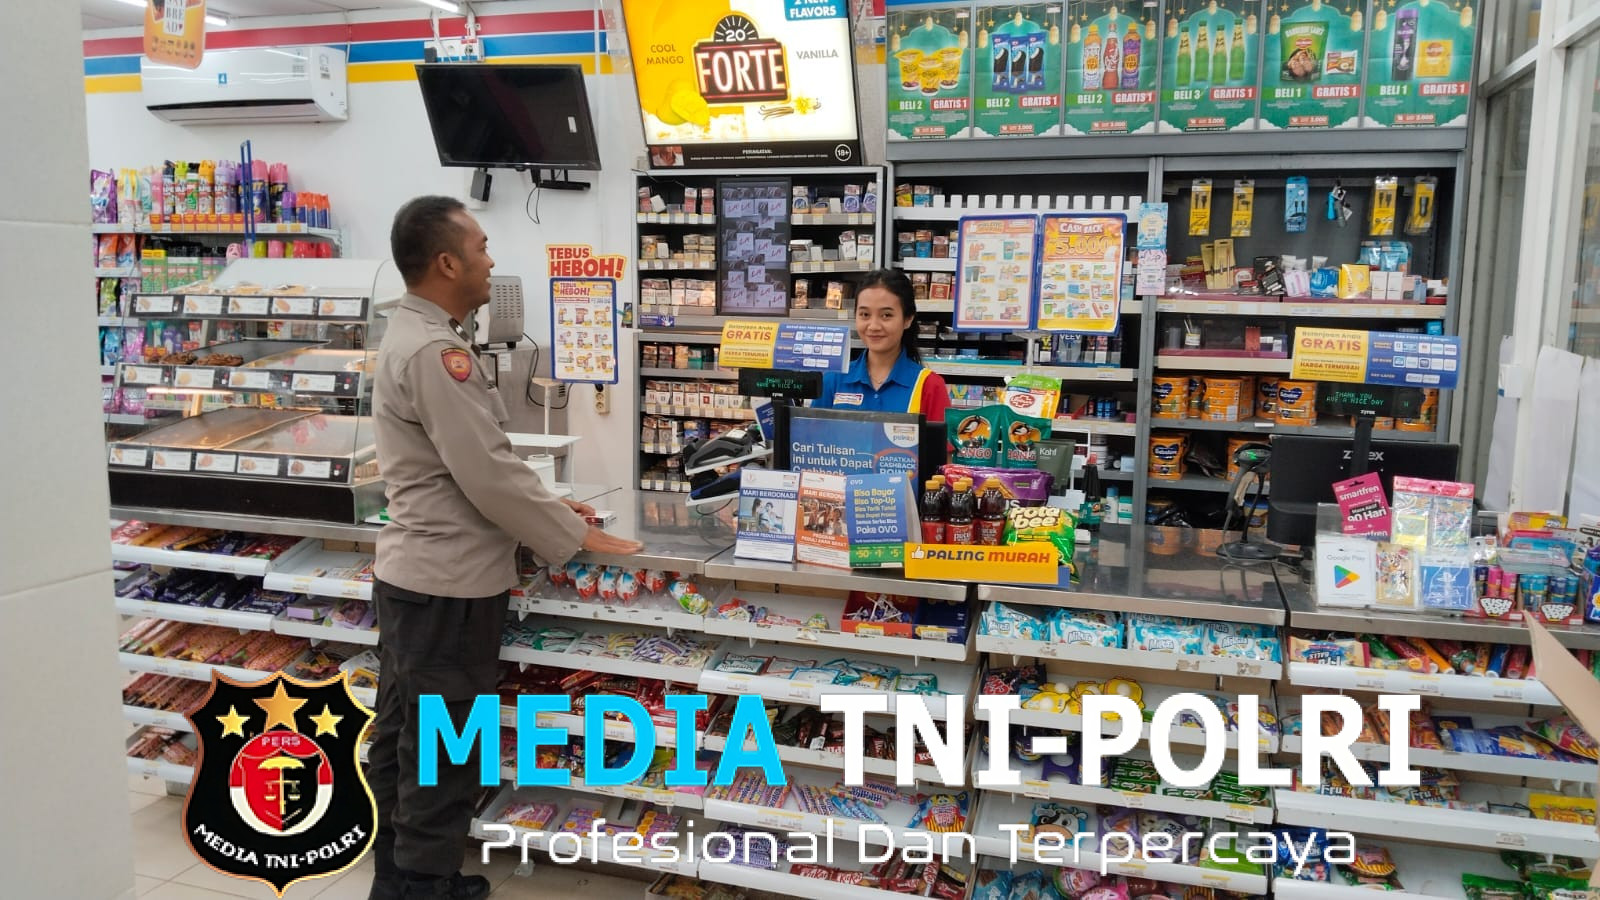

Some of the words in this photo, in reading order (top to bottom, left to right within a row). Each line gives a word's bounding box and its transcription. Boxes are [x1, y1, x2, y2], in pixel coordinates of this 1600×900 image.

[790, 6, 836, 18] FLAVORS
[726, 30, 745, 42] 20
[650, 44, 676, 53] COOL
[796, 48, 839, 60] VANILLA
[646, 55, 684, 65] MANGO
[695, 48, 787, 94] FORTE
[220, 74, 227, 83] 4
[1173, 89, 1193, 100] BELI
[1193, 89, 1201, 100] 3
[1213, 87, 1246, 99] GRATIS
[1274, 88, 1294, 99] BELI
[1296, 87, 1302, 98] 1
[1316, 86, 1350, 97] GRATIS
[1379, 85, 1400, 96] BELI
[1402, 85, 1408, 95] 1
[1422, 83, 1458, 95] GRATIS
[986, 98, 1003, 109] BELI
[1004, 97, 1011, 107] 2
[1021, 96, 1050, 107] GRATIS
[1077, 94, 1095, 105] BELI
[1095, 94, 1103, 104] 2
[1114, 92, 1145, 103] GRATIS
[899, 100, 916, 111] BELI
[916, 100, 923, 110] 2
[933, 99, 960, 110] GRATIS
[836, 148, 850, 157] 18+
[1059, 222, 1082, 234] CASH
[549, 247, 590, 259] TEBUS
[550, 258, 624, 278] HEBOH!
[560, 288, 591, 296] HEBOH!
[726, 330, 772, 341] GRATIS
[1301, 337, 1362, 351] GRATIS
[792, 441, 815, 452] Cari
[817, 443, 856, 456] Tulisan
[792, 455, 805, 464] ini
[807, 456, 838, 466] untuk
[840, 459, 873, 470] Dapat
[879, 462, 916, 470] CASHBACK
[759, 490, 796, 499] BERDONASI
[871, 488, 896, 497] Bayar
[1339, 485, 1379, 501] smartfren
[871, 496, 896, 505] Top-Up
[1009, 506, 1060, 518] pota
[1364, 507, 1387, 520] Hari
[1014, 515, 1058, 530] bee
[878, 525, 898, 534] OVO
[926, 550, 985, 561] PALING
[988, 551, 1051, 563] MURAH
[1326, 554, 1350, 563] Google
[1481, 597, 1514, 609] PUSH
